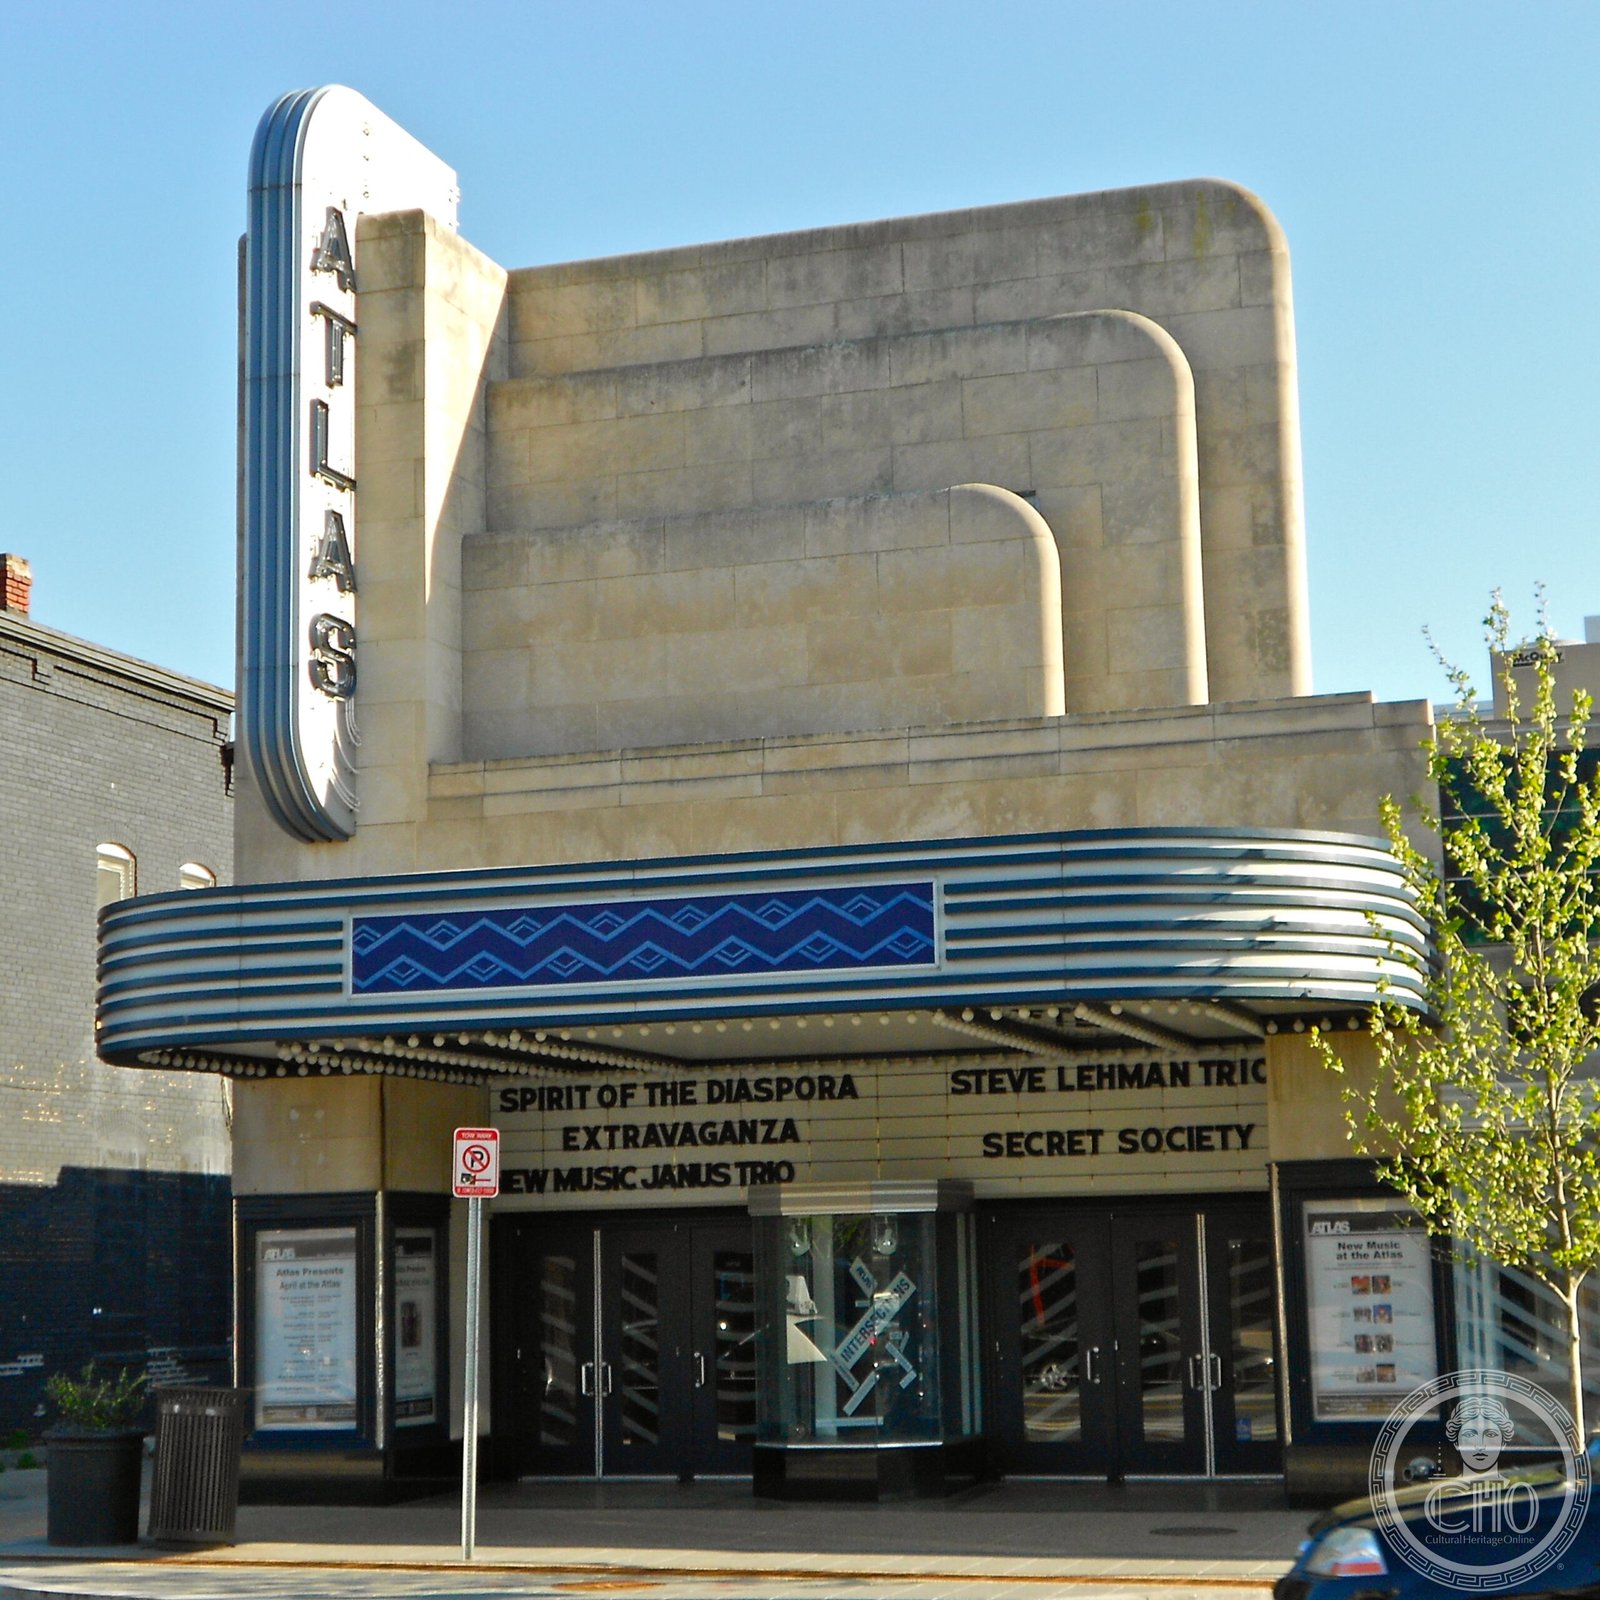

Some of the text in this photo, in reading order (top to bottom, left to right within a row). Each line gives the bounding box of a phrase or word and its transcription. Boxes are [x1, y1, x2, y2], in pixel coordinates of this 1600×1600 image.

[308, 205, 358, 701] ATLAS
[500, 1074, 859, 1113] SPIRIT OF THE DIASPORA
[951, 1066, 1046, 1095] STEVE
[1057, 1060, 1190, 1092] LEHMAN
[562, 1118, 800, 1151] EXTRAVAGANZA
[983, 1123, 1255, 1158] SECRET SOCIETY
[553, 1165, 637, 1193] MUSIC
[640, 1162, 732, 1190] JANUS
[734, 1160, 795, 1187] TRIO
[1311, 1220, 1350, 1234] ATLAS
[1336, 1251, 1403, 1260] at the Atlas
[1337, 1241, 1400, 1251] New Music
[276, 1267, 344, 1277] Atlas Presents
[280, 1281, 297, 1290] April
[321, 1280, 341, 1288] Atlas
